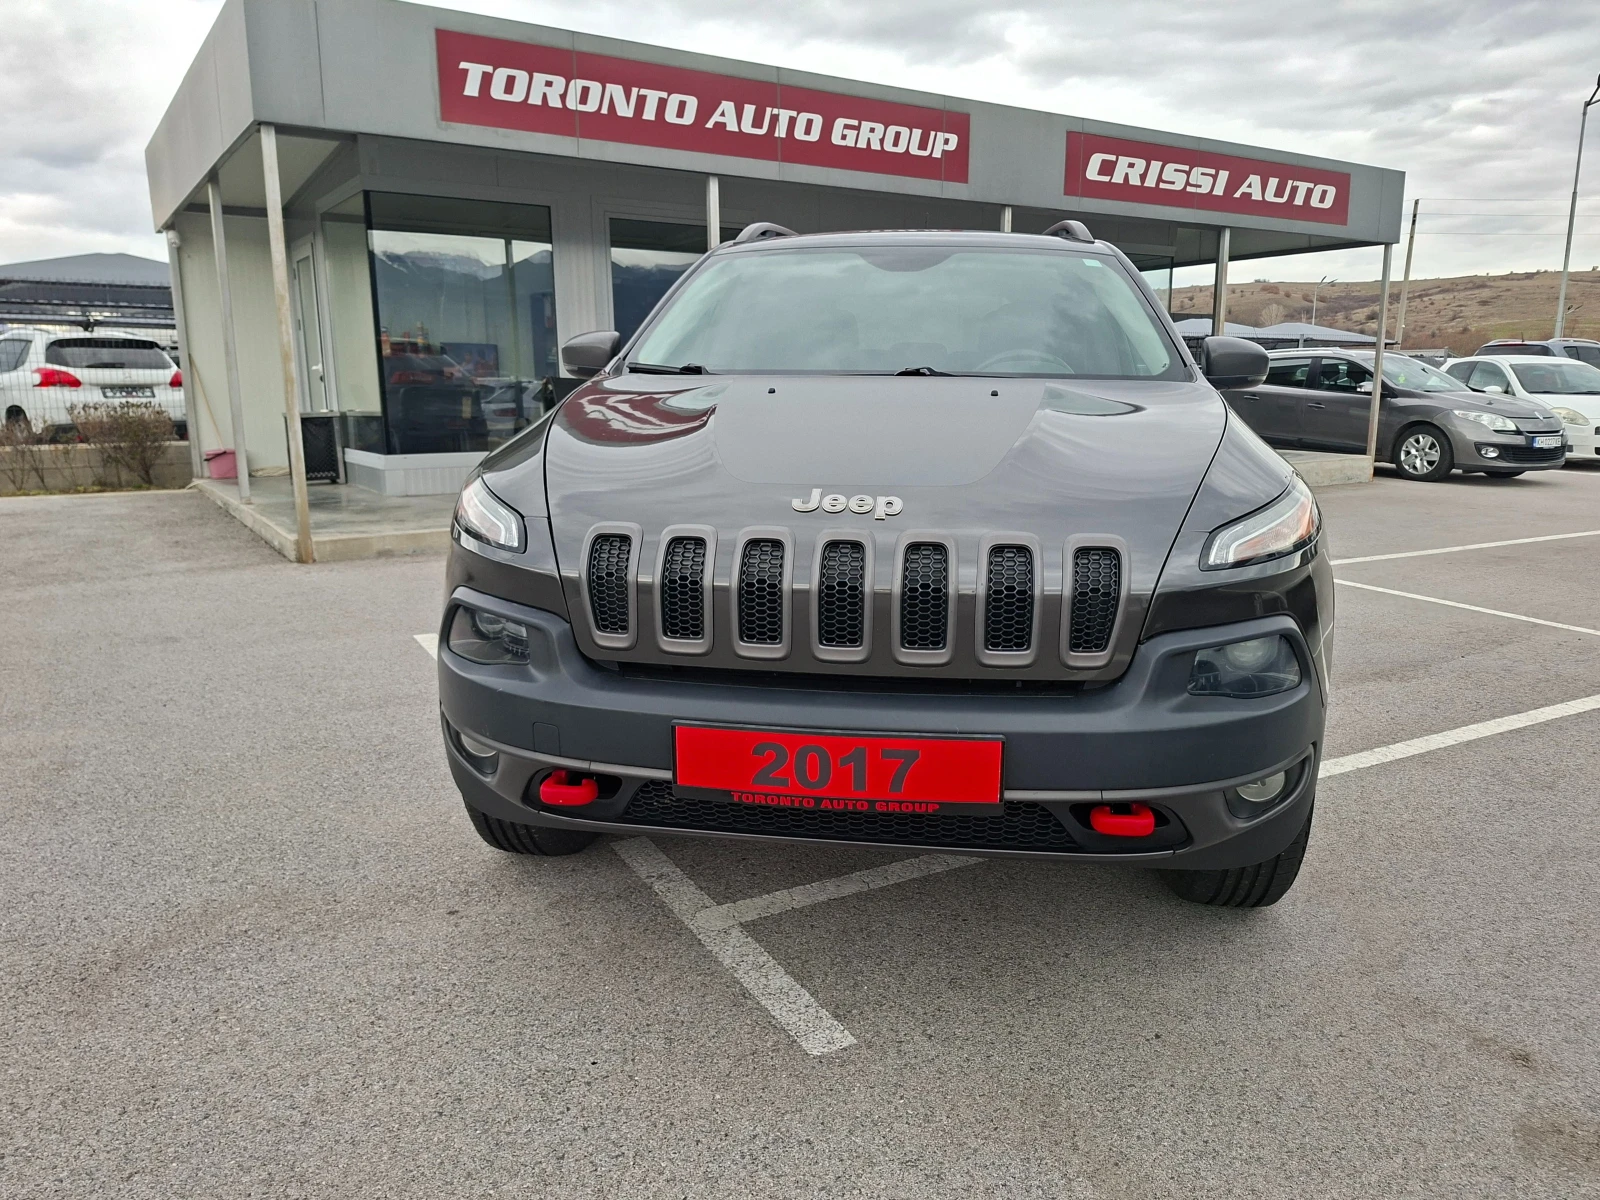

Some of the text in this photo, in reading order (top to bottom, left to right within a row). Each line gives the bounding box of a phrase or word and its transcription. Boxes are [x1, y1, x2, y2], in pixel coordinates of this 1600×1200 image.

[458, 61, 959, 159] TORONTO AUTO GROUP
[1085, 152, 1337, 209] CRISSI AUTO
[791, 488, 904, 520] Jeep
[751, 742, 921, 793] 2017
[730, 791, 940, 813] TORONTO AUTO GROUP
